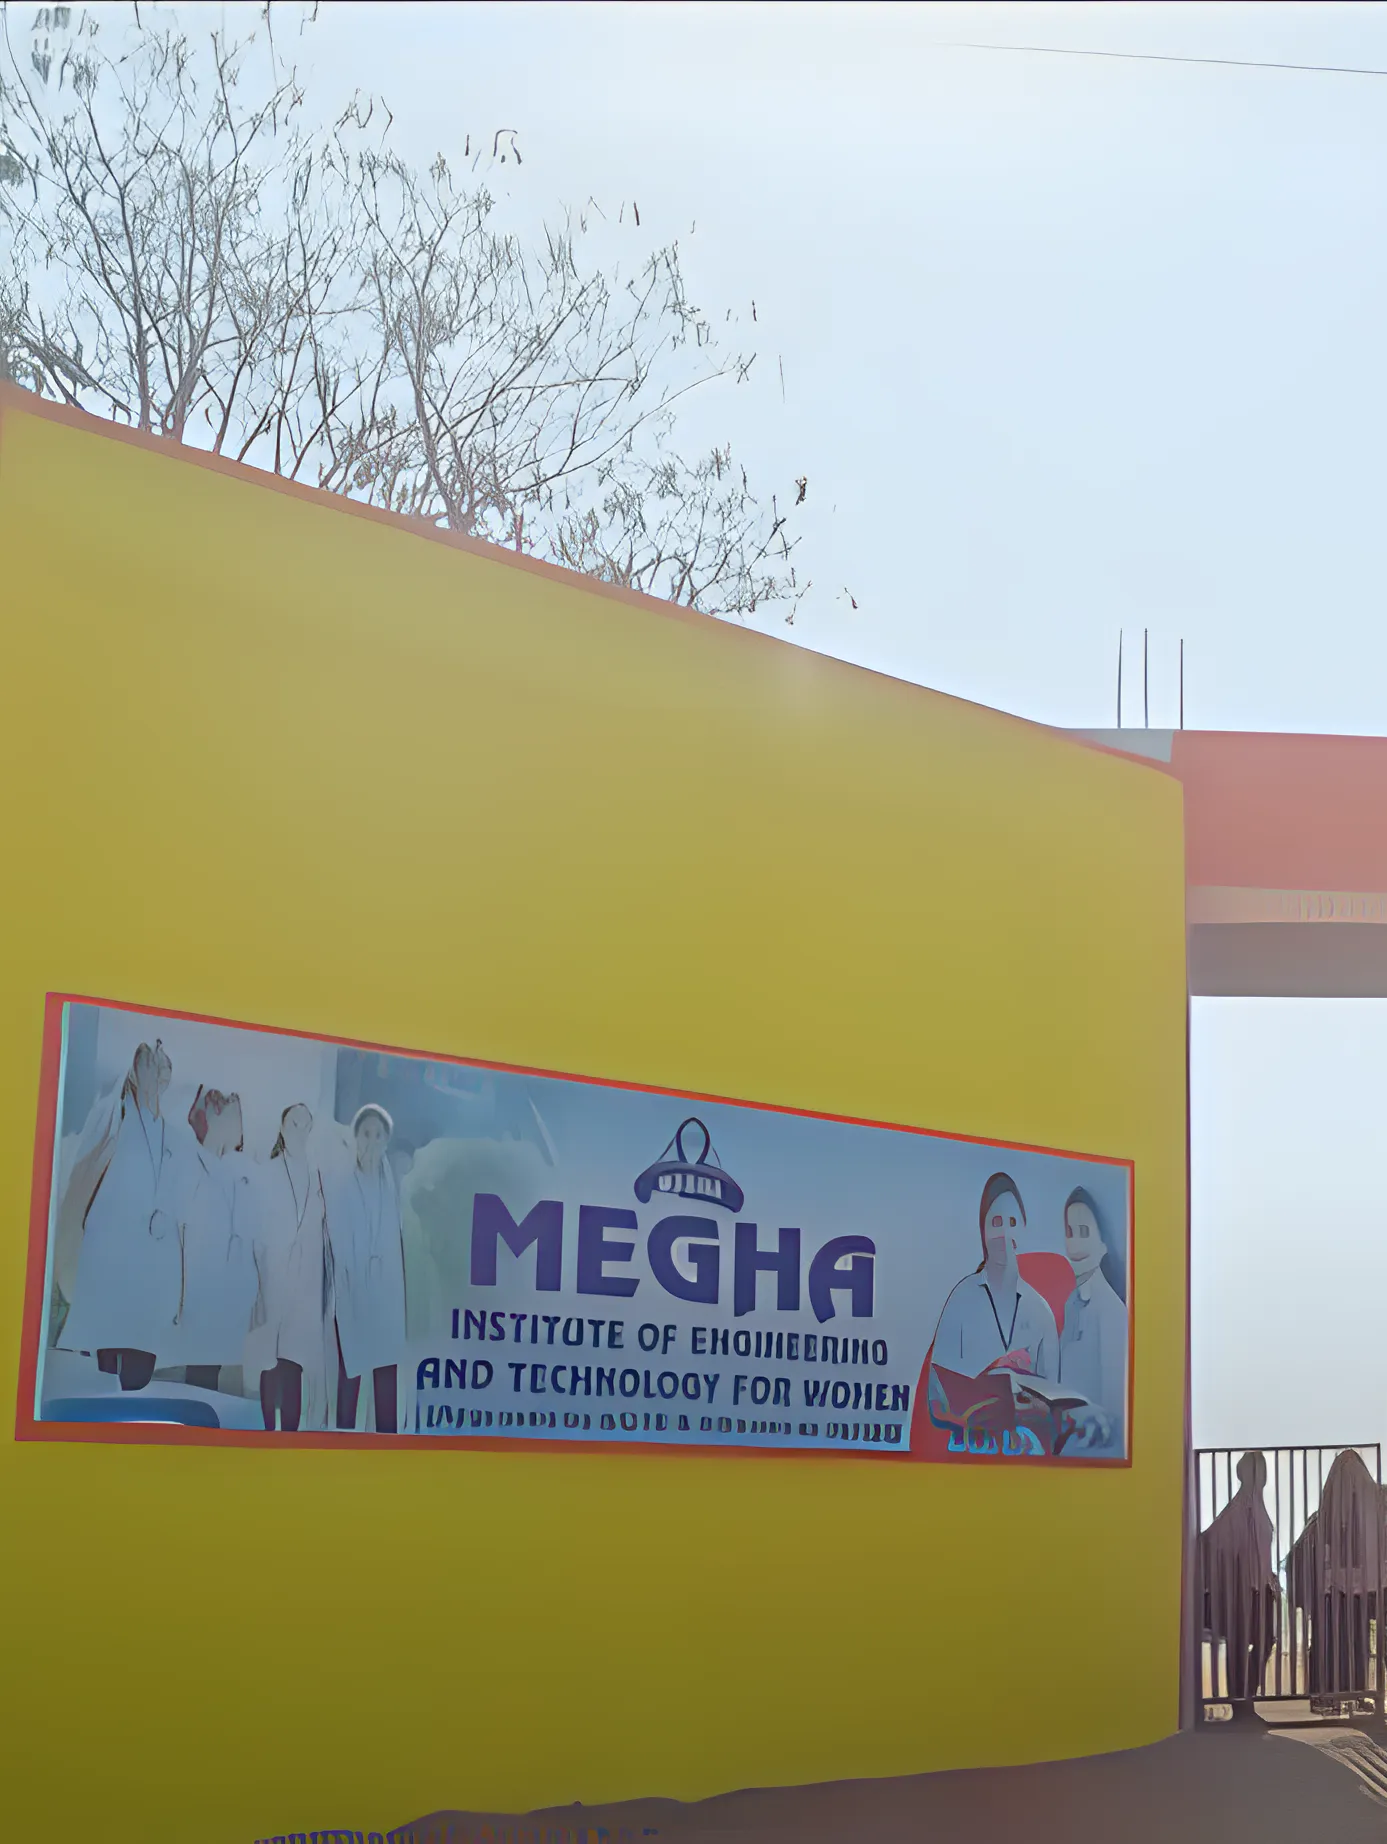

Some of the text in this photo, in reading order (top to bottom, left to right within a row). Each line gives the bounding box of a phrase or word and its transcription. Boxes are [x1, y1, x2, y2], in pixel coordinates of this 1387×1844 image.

[470, 1192, 876, 1323] MEGHA
[451, 1308, 625, 1350] INSTITUTE
[637, 1323, 678, 1355] OF
[416, 1357, 494, 1391] AND
[733, 1374, 791, 1407] FOR
